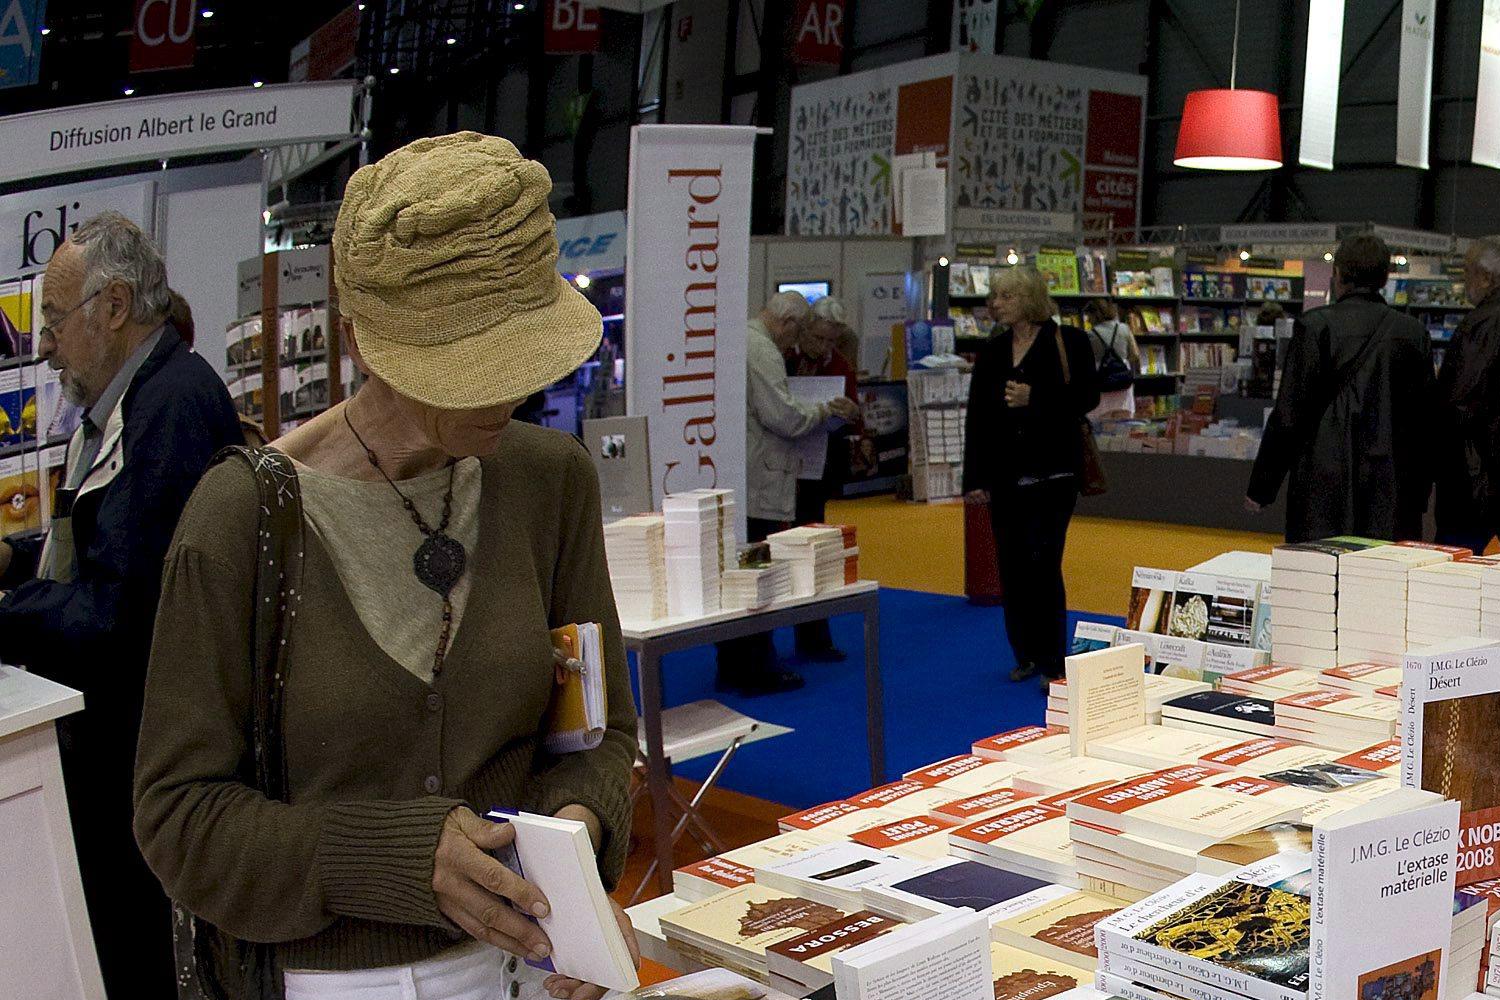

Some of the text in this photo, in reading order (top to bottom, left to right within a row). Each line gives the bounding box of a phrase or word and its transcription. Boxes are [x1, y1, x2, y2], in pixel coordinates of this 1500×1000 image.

[799, 3, 845, 48] AR
[50, 106, 278, 151] Diffusion Albert le Grand
[1013, 111, 1034, 127] DES
[1029, 129, 1084, 145] FORMATION
[18, 202, 82, 270] foli
[662, 164, 723, 495] Gallimard
[1405, 660, 1422, 670] 1670
[1429, 656, 1488, 676] J.M.G. Le Clézio
[1429, 676, 1462, 690] Désert
[1350, 826, 1452, 865] J.M.G. Le Clézio
[1396, 853, 1449, 877] L'extase
[1455, 847, 1495, 872] 2008
[1380, 870, 1448, 900] matérielle
[788, 915, 884, 955] BESSORA
